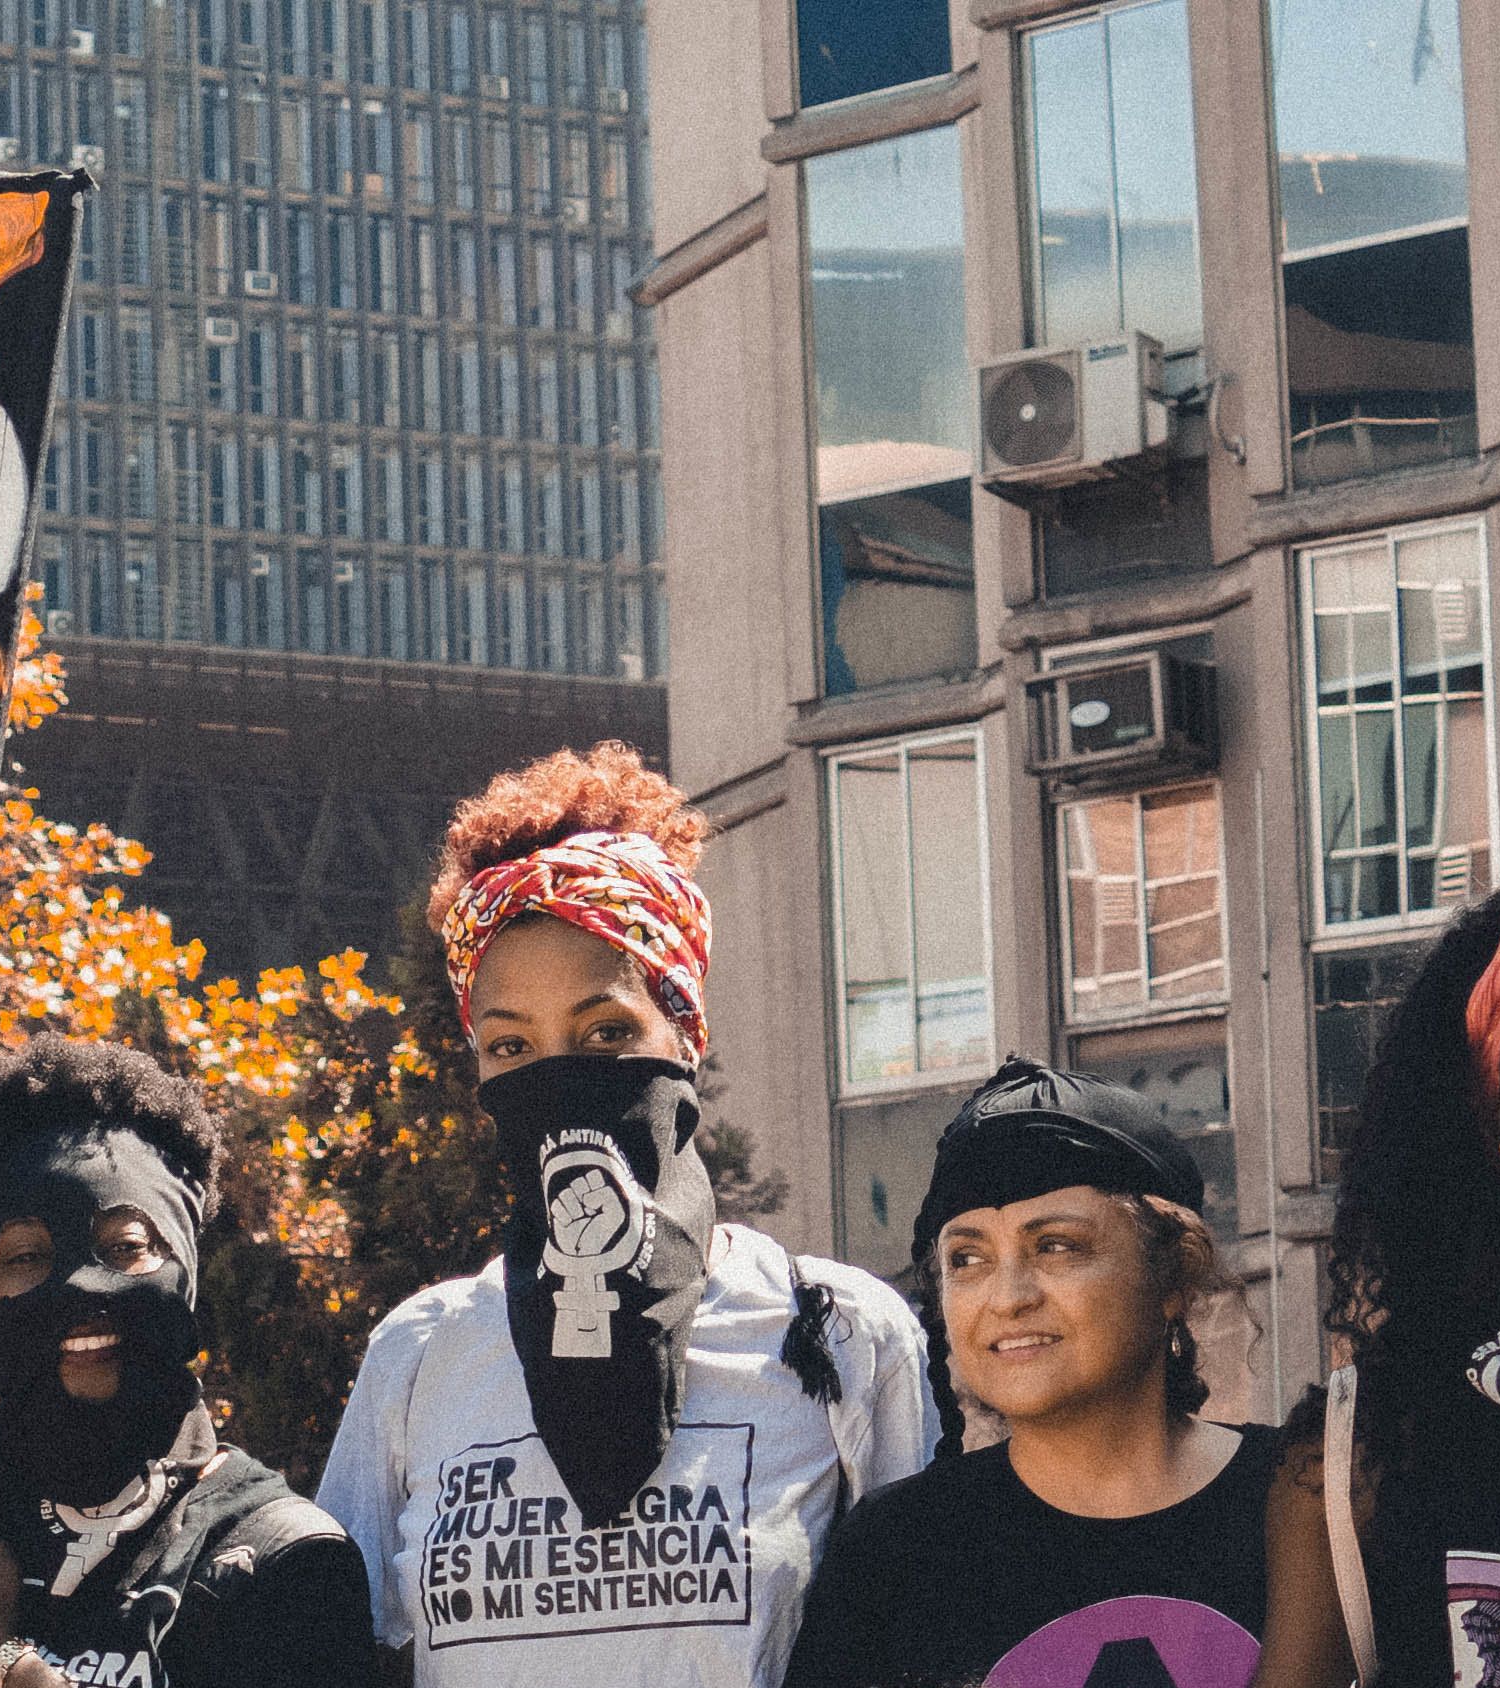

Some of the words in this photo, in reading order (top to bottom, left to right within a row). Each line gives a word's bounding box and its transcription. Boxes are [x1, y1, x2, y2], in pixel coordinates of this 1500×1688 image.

[444, 1457, 516, 1508] SER
[433, 1497, 568, 1545] MUJER
[429, 1544, 473, 1587] ES
[485, 1538, 533, 1581] MI
[547, 1525, 738, 1576] ESENCIA
[430, 1588, 473, 1626] NO
[484, 1584, 524, 1620] MI
[535, 1568, 738, 1615] SENTENCIA
